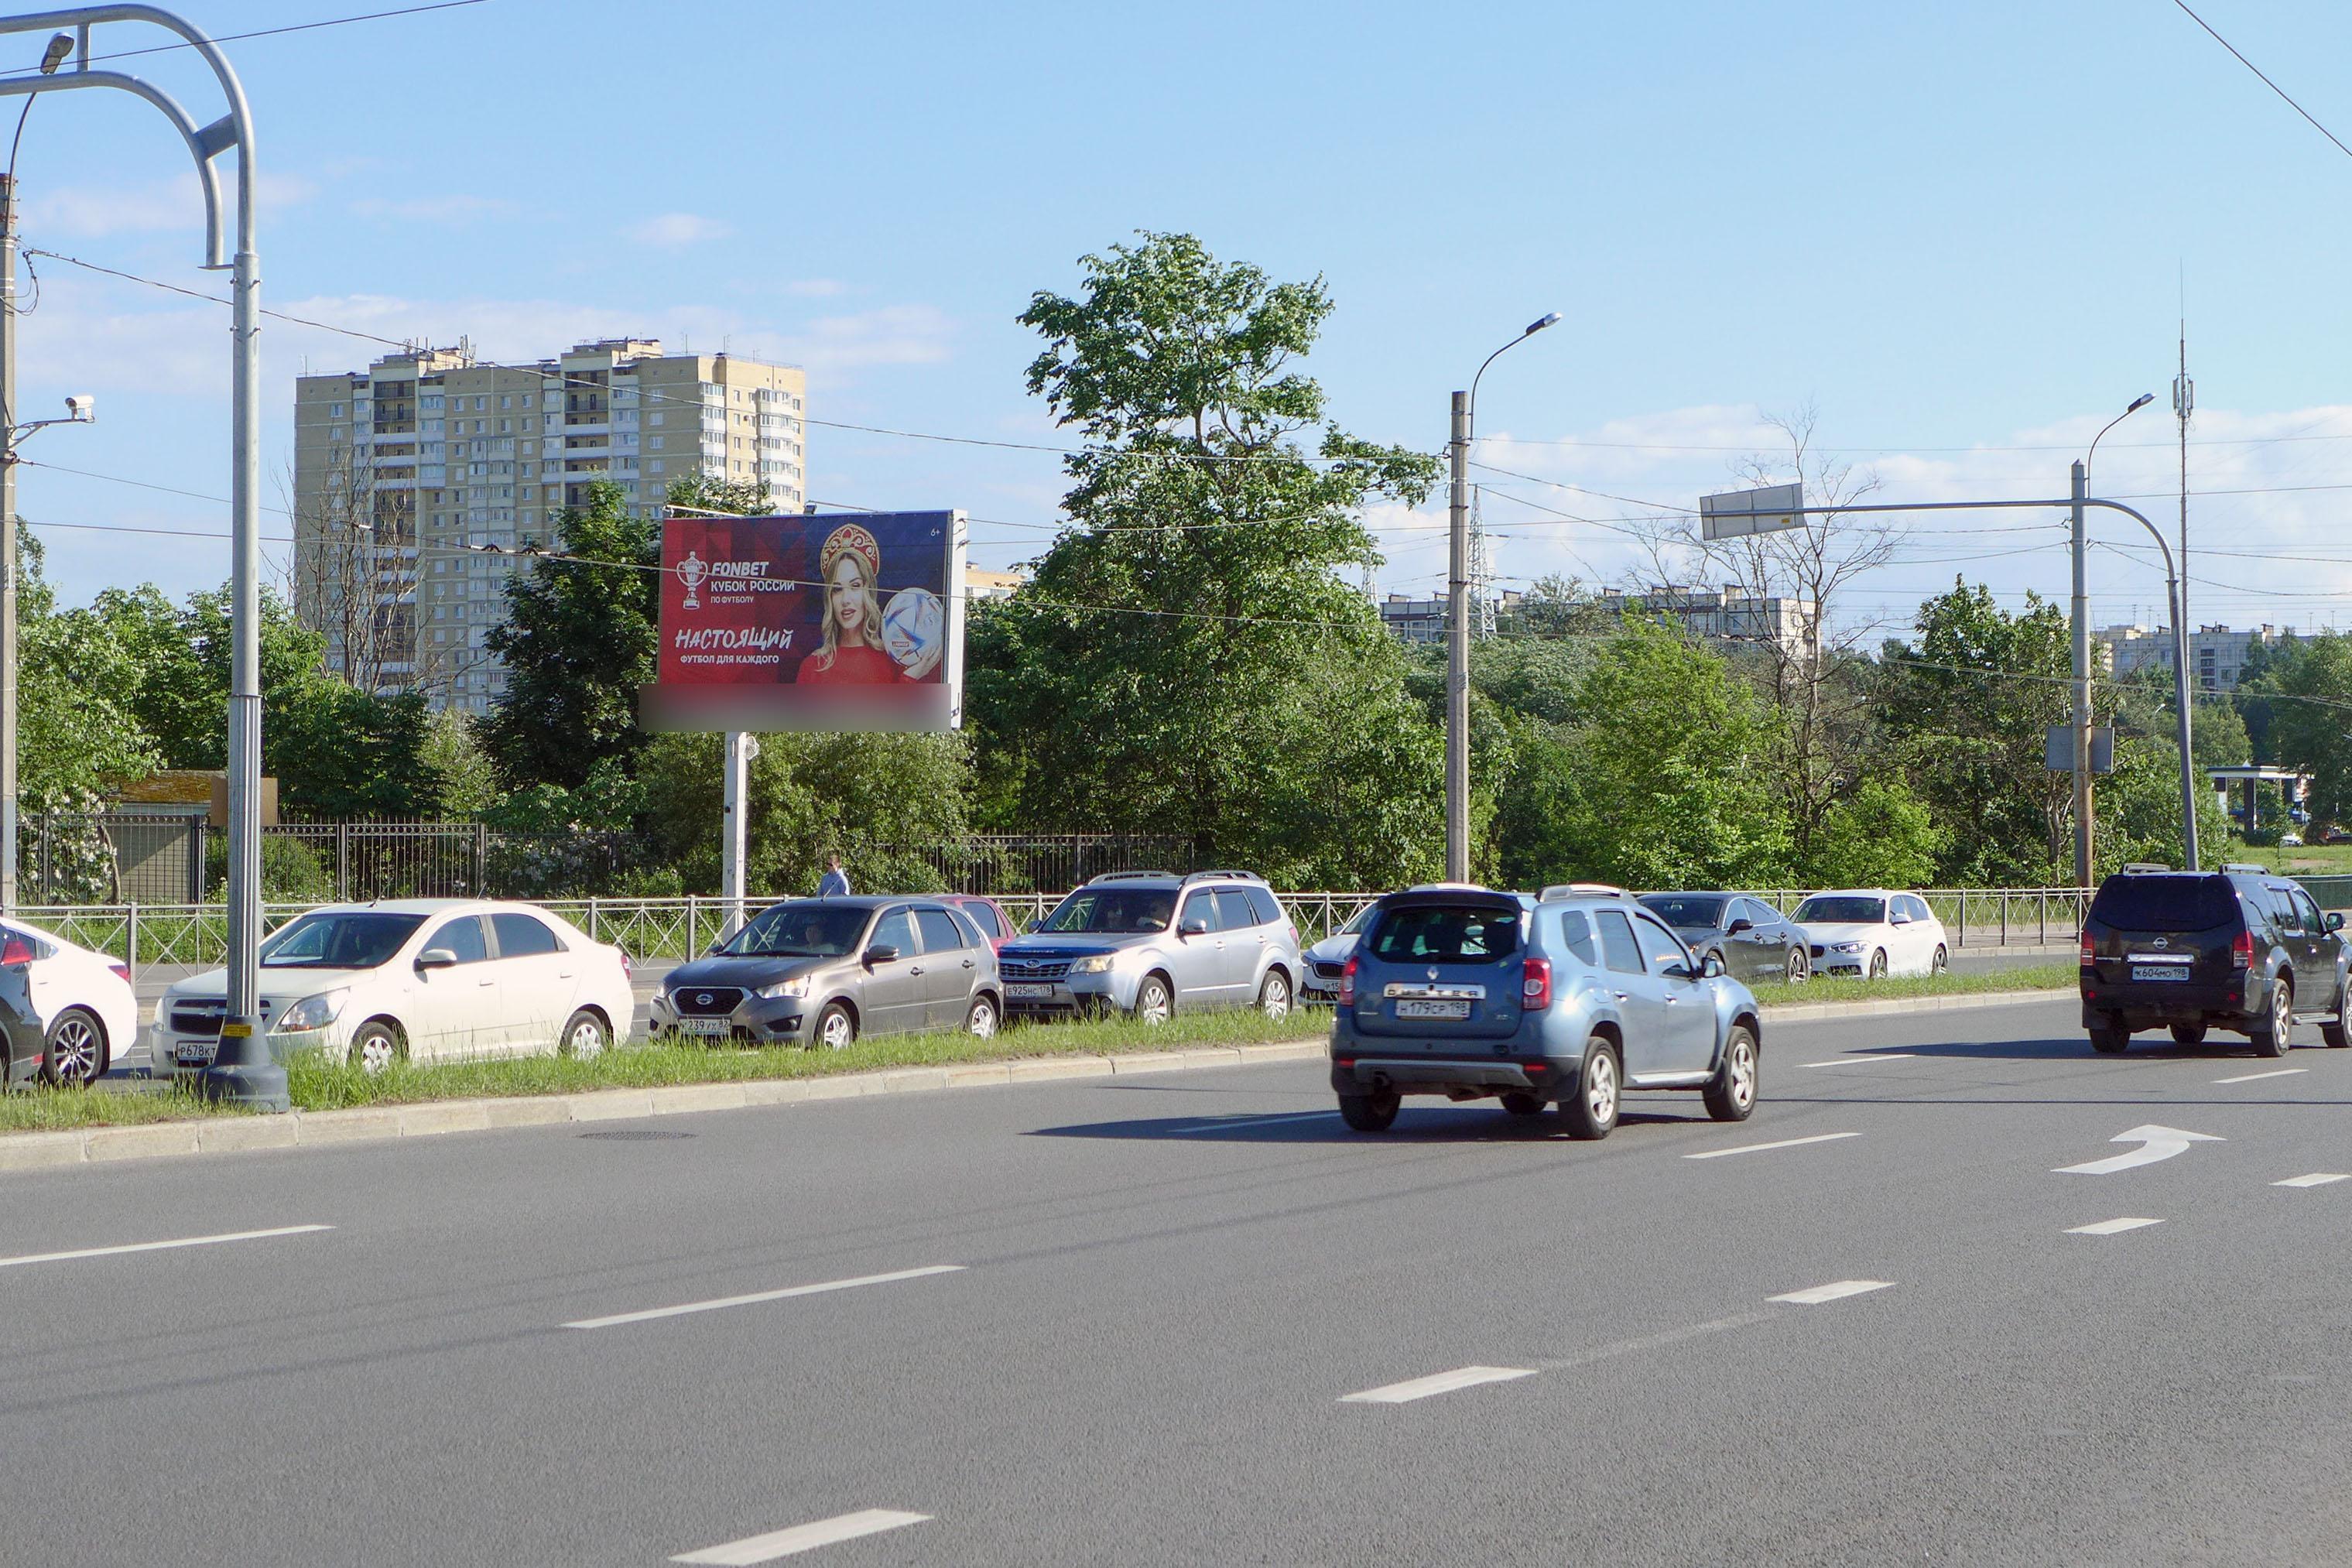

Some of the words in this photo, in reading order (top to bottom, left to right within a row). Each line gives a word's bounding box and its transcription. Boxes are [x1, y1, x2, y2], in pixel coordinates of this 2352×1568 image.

[930, 528, 940, 536] 6+
[712, 561, 769, 577] FONBET
[710, 580, 746, 592] КУБОК
[749, 580, 795, 592] РОССИИ
[721, 595, 755, 604] ФУТБОЛУ
[675, 627, 794, 651] НАСТОЯЩИЙ
[680, 654, 714, 663] ФУТБОЛ
[717, 655, 734, 665] ДЛЯ
[736, 655, 779, 665] КАЖДОГО
